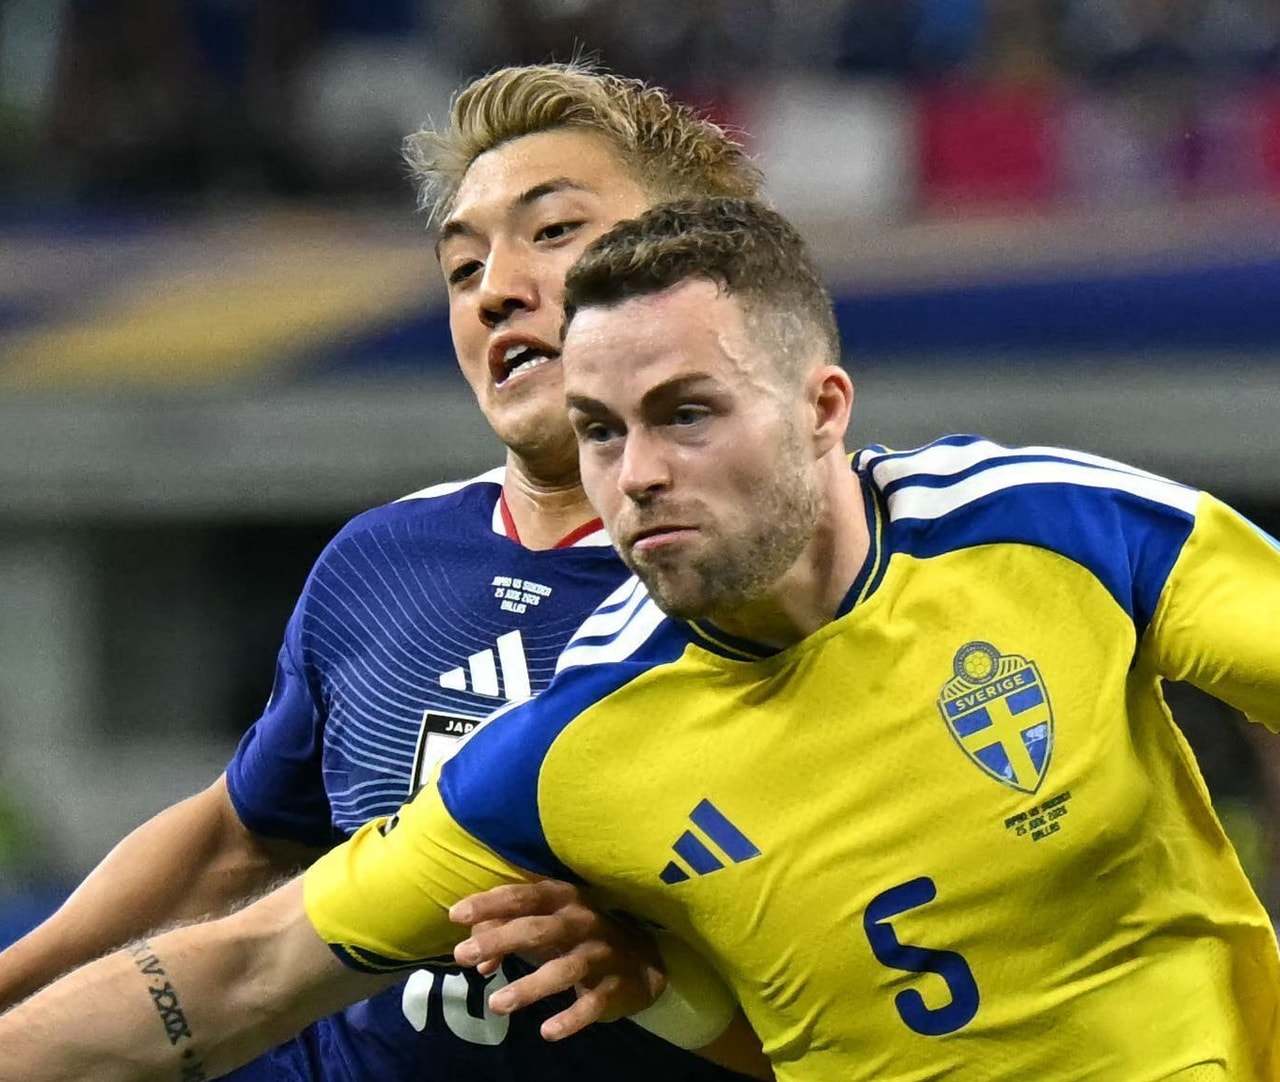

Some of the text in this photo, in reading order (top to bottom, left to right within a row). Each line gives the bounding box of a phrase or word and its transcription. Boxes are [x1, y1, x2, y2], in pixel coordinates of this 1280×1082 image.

[955, 674, 1025, 711] SVERIGE
[445, 720, 474, 734] JAP
[863, 876, 980, 1036] 5
